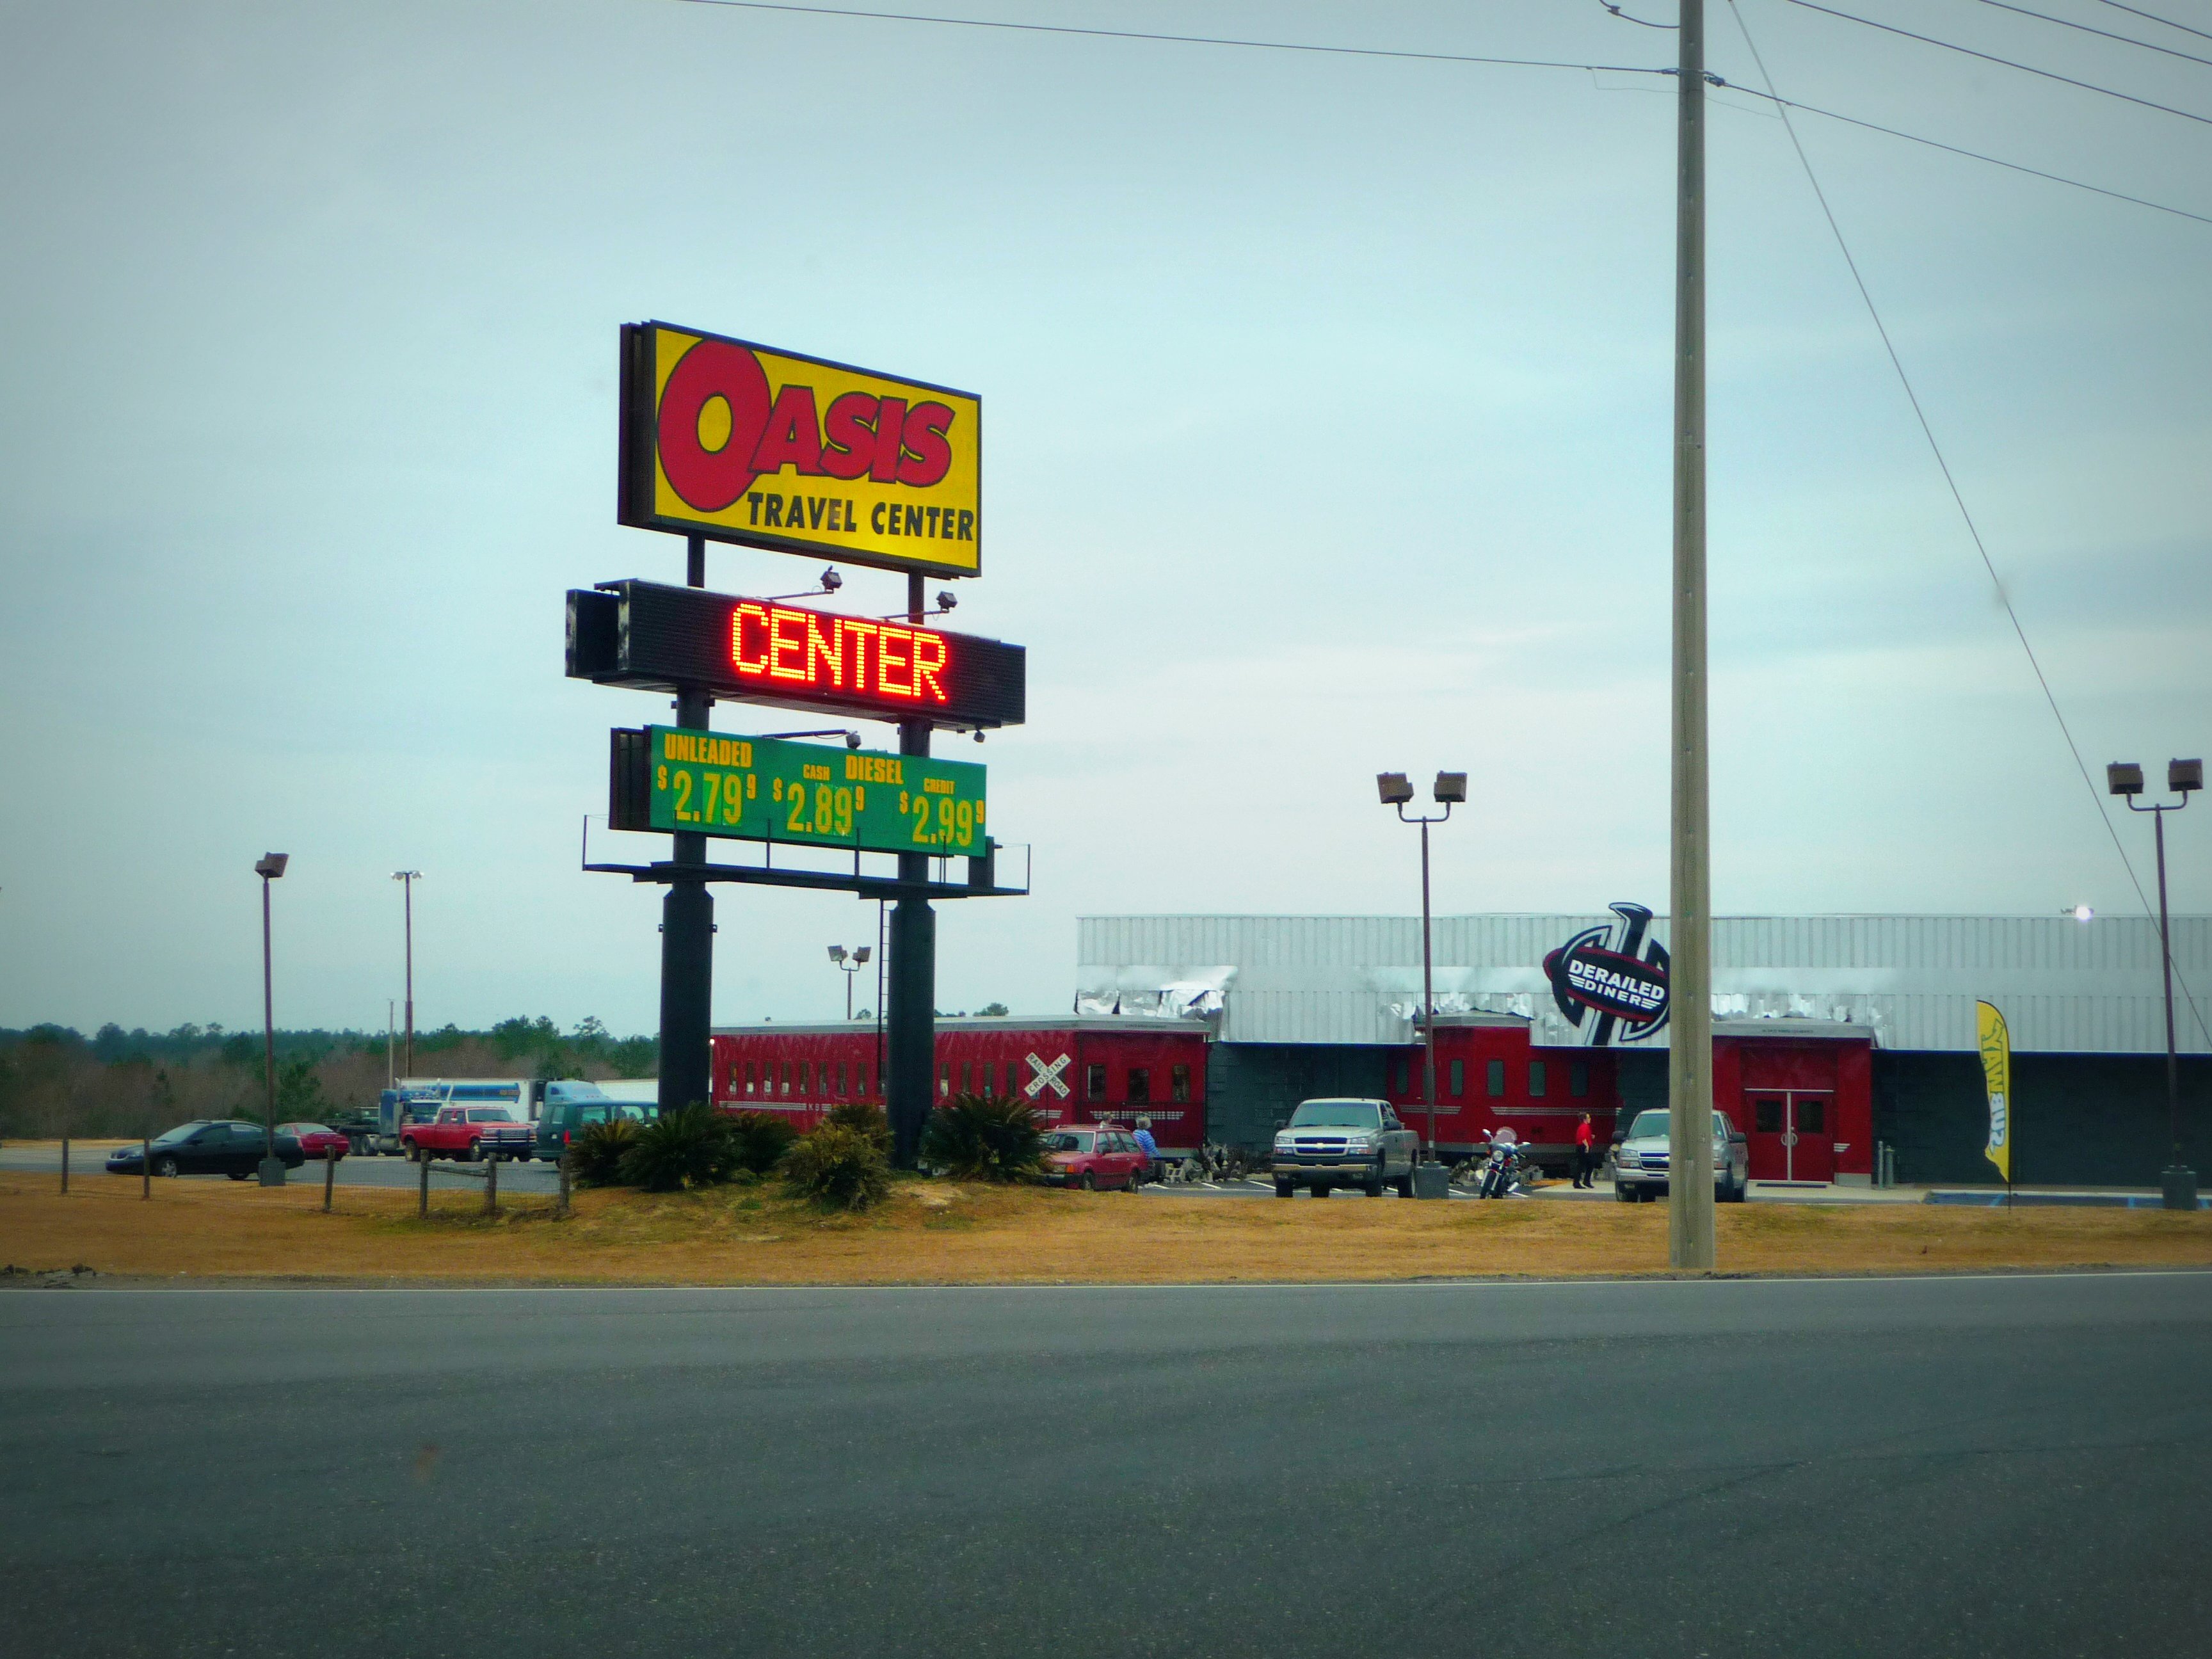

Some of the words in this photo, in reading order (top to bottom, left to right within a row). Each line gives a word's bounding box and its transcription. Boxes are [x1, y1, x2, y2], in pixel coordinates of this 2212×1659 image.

[657, 339, 956, 513] OASIS
[746, 492, 857, 533] TRAVEL
[870, 502, 974, 541] CENTER
[732, 602, 946, 701] CENTER
[664, 733, 753, 768] UNLEADED
[803, 764, 831, 781] CASH
[846, 755, 904, 785] DIESEL
[923, 777, 956, 795] CREDIT
[1568, 959, 1665, 1000] DERAILED
[1584, 981, 1643, 1007] DINER
[1028, 1057, 1067, 1093] CROSSING
[1050, 1076, 1068, 1094] ROAD
